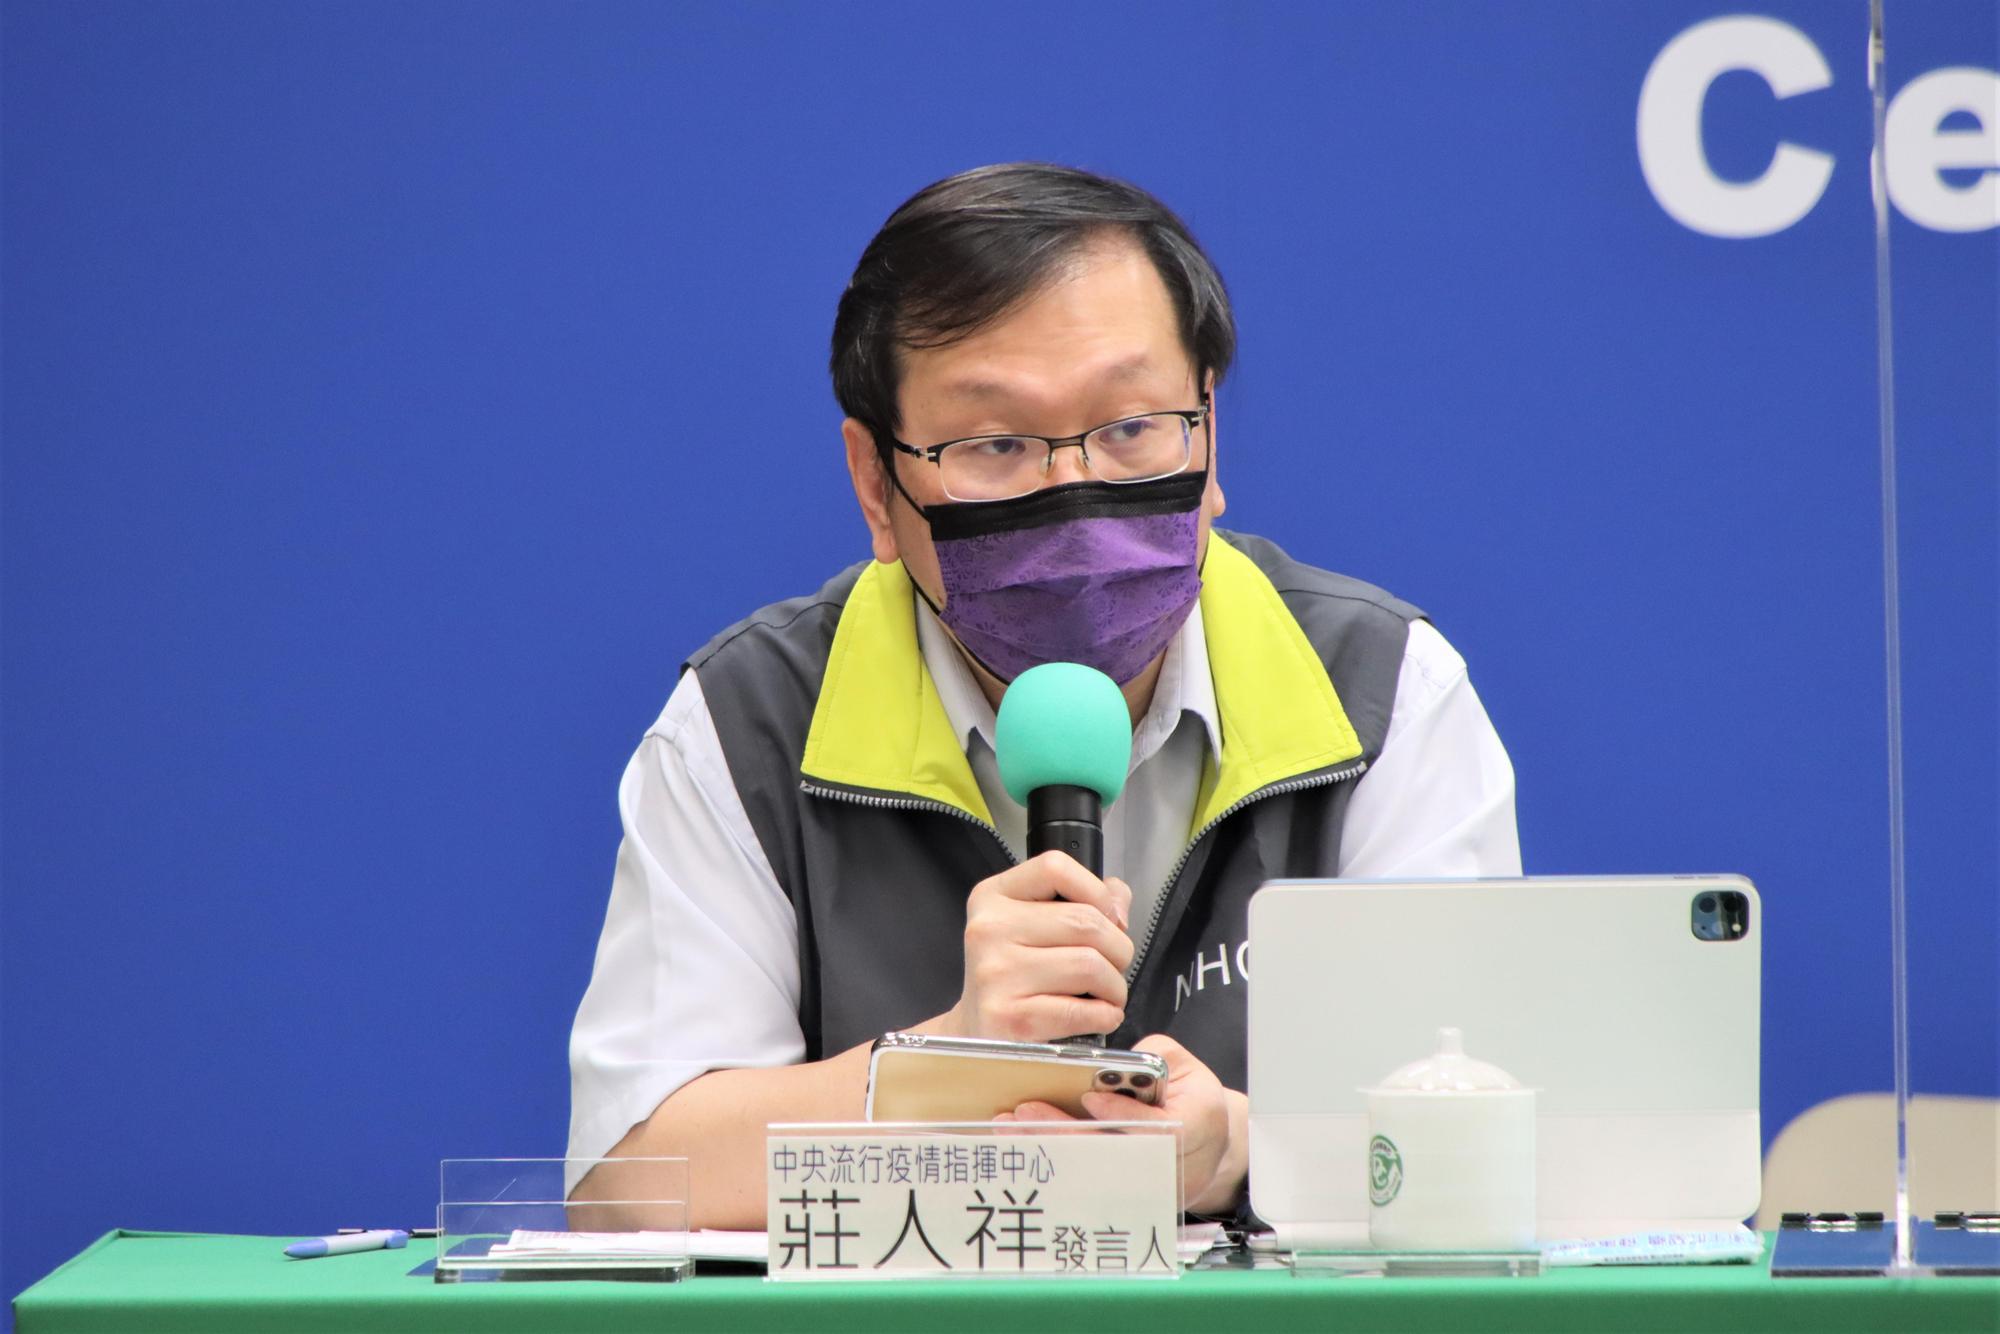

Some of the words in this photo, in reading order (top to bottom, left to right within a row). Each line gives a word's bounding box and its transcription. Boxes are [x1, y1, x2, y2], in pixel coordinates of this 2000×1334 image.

[773, 1144, 1055, 1184] 中央流行疫情指揮中心
[779, 1189, 1046, 1270] 莊人祥
[1051, 1225, 1173, 1273] 發言人
